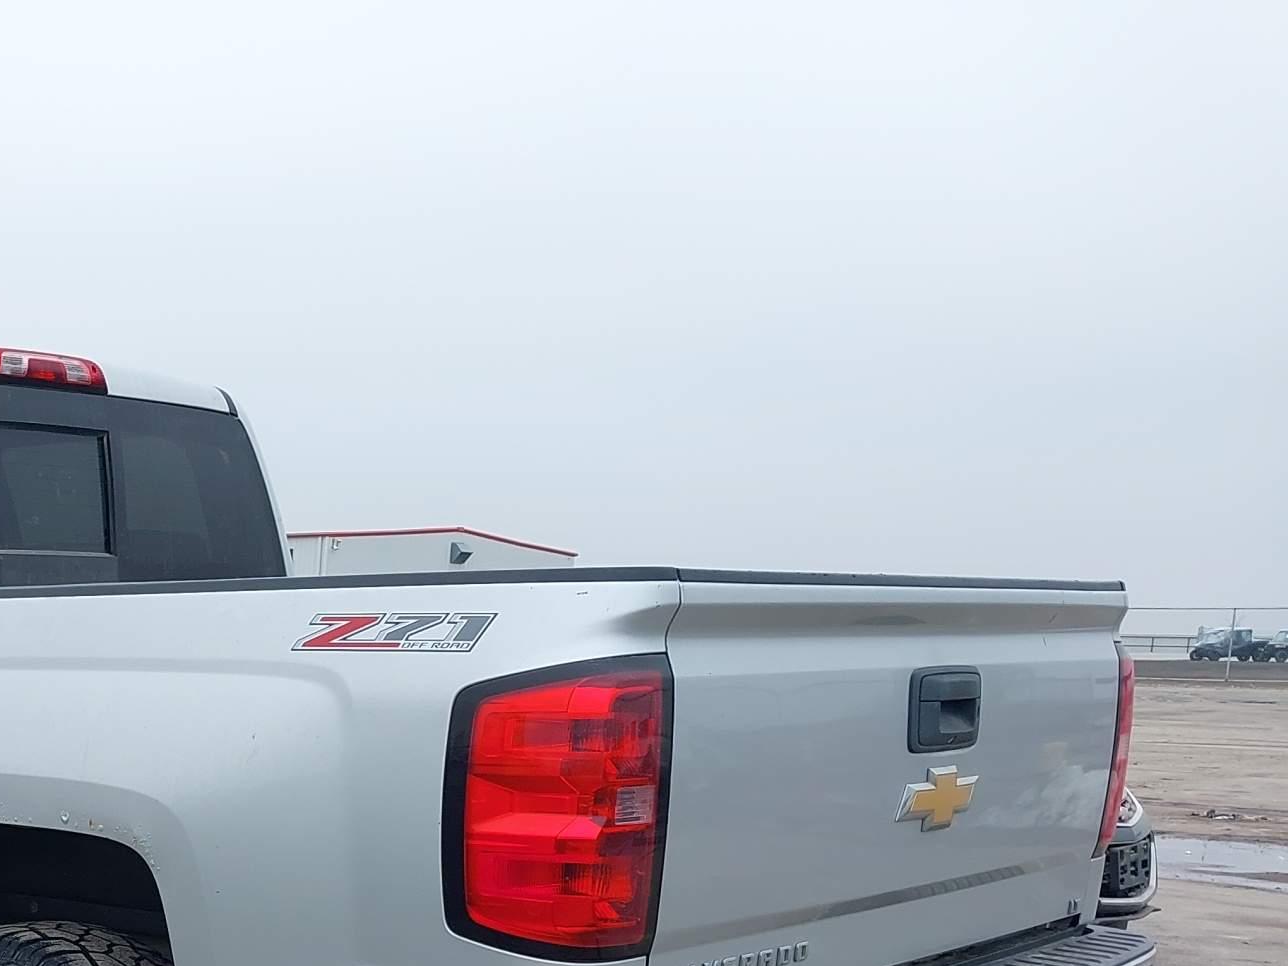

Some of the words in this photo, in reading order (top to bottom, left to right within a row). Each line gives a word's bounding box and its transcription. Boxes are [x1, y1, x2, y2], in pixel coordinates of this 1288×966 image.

[291, 612, 498, 652] Z71
[401, 641, 429, 649] OFF
[431, 642, 470, 650] ROAD
